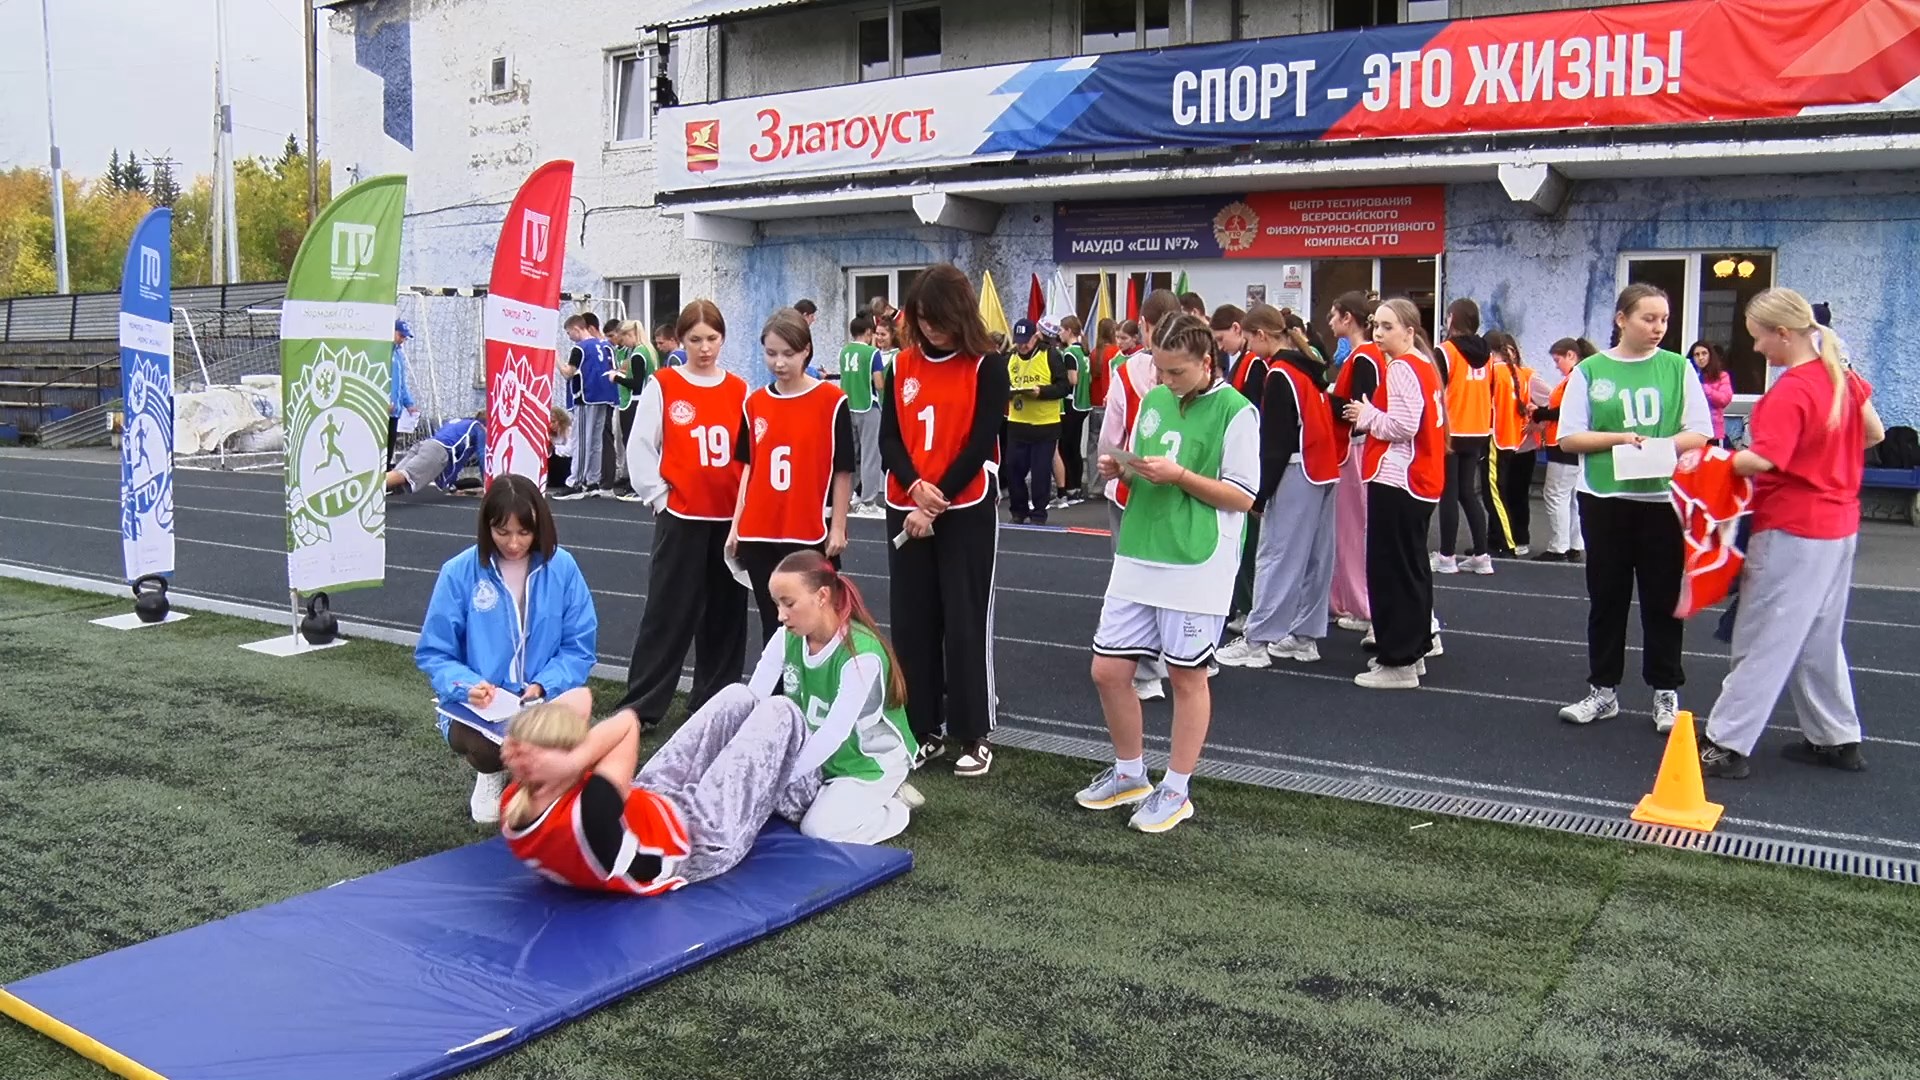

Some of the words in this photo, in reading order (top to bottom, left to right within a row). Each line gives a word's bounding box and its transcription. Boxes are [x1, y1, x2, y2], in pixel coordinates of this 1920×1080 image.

[1172, 60, 1315, 126] СПОРТ
[1361, 48, 1452, 111] ЭТО
[1464, 30, 1683, 105] ЖИЗНЬ!
[750, 108, 936, 163] Златоуст
[1289, 199, 1324, 210] ЦЕНТР
[1326, 196, 1412, 208] ТЕСТИРОВАНИЯ
[1301, 210, 1398, 222] ВСЕРОССИЙСКОГО
[1266, 221, 1436, 236] ФИЗКУЛЬТУРНО-СПОРТИВНОГО
[1304, 236, 1370, 247] КОМПЛЕКСА
[1371, 233, 1399, 246] ГТО
[1071, 239, 1124, 255] МАУДО
[1128, 238, 1160, 252] «СШ
[1165, 237, 1199, 250] №7»
[844, 352, 859, 372] 14
[1618, 387, 1660, 428] 10
[918, 405, 934, 451] 1
[690, 425, 730, 467] 19
[770, 445, 791, 492] 6
[135, 480, 158, 512] ГТО
[320, 480, 363, 516] ГТО
